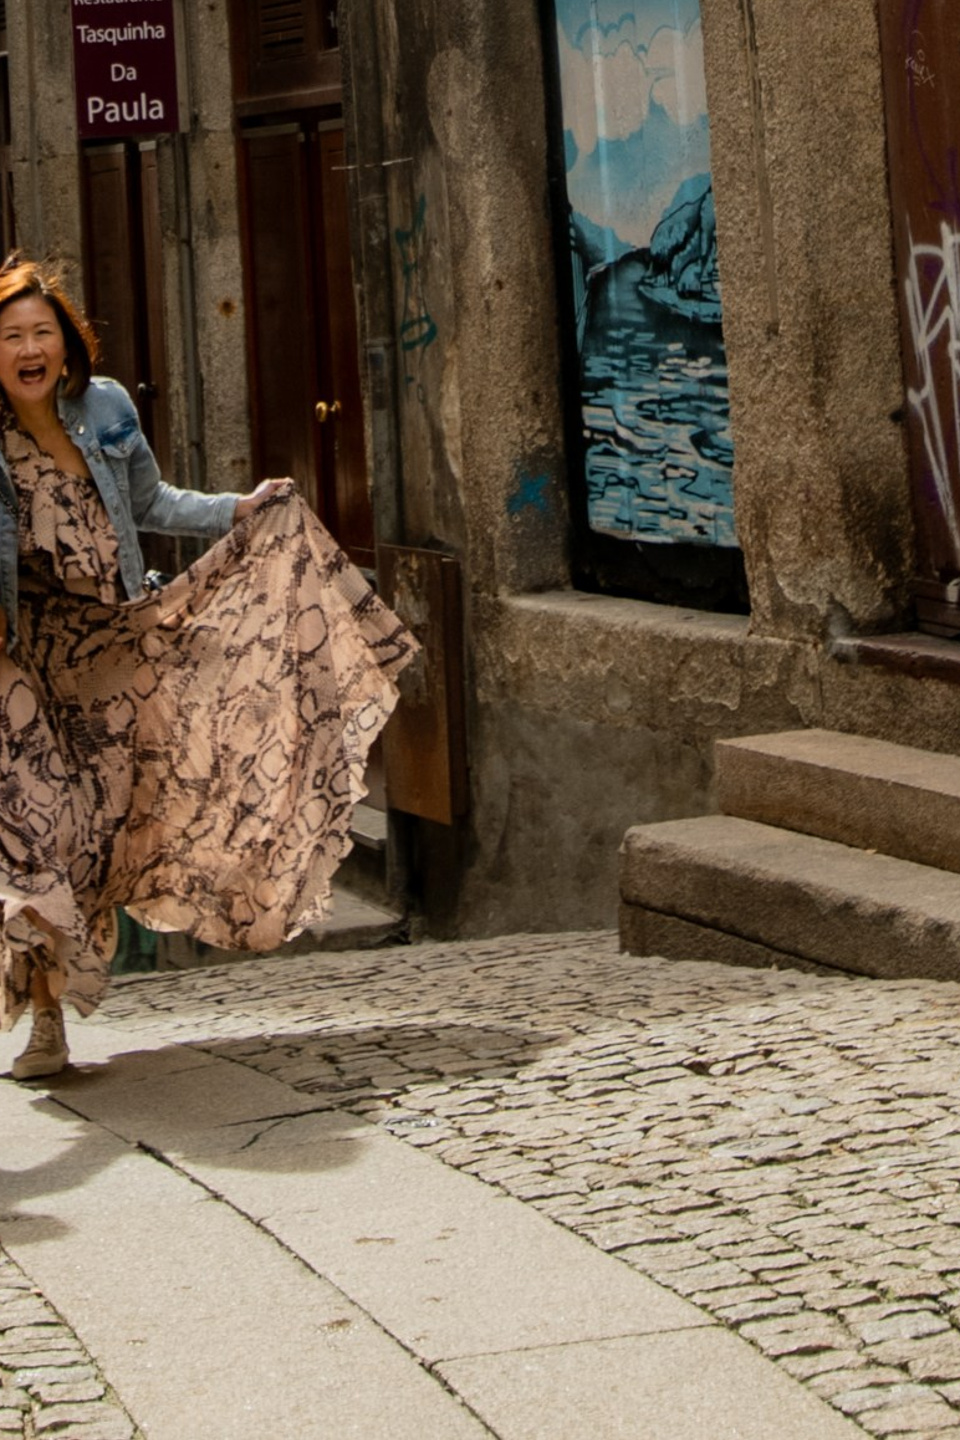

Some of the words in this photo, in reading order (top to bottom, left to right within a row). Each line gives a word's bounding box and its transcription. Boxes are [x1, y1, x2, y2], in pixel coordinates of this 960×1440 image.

[76, 21, 166, 46] Tasquinha
[110, 63, 137, 82] Da
[87, 92, 164, 124] Paula
